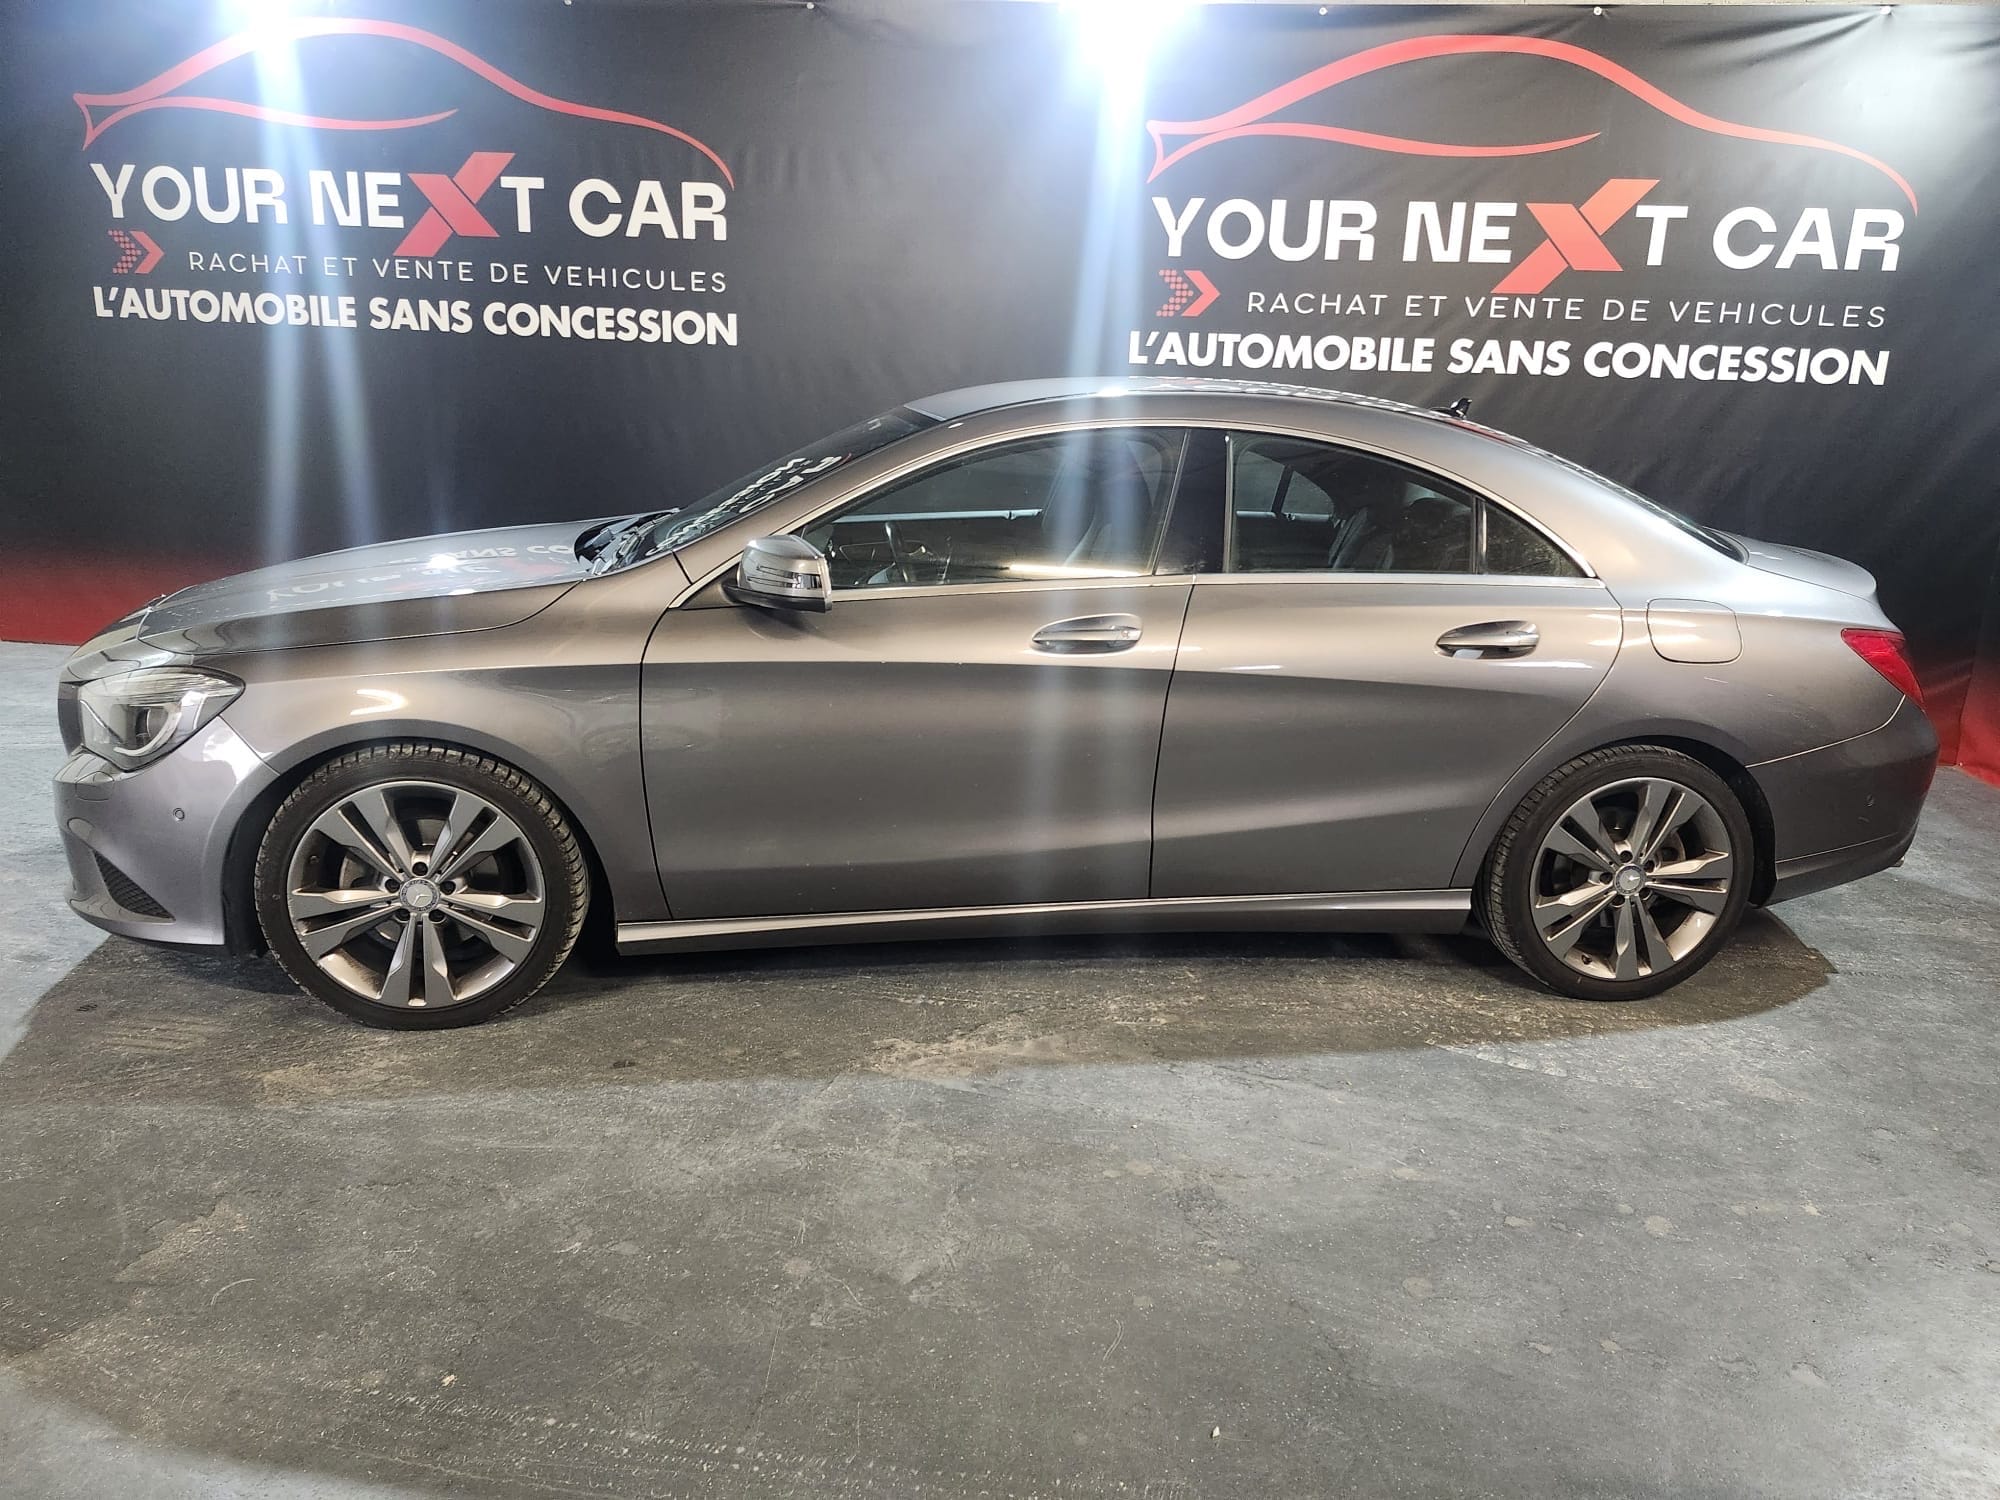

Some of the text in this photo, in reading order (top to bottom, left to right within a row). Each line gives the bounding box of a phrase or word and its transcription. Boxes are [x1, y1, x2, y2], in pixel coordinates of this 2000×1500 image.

[90, 151, 728, 258] YOUR NEXT CAR
[1151, 178, 1905, 294] YOUR NEXT CAR
[188, 251, 727, 293] RACHAT ET VENTE DE VEHICULES
[93, 286, 739, 346] L'AUTOMOBILE SANS CONCESSION
[1247, 291, 1886, 328] RACHAT ET VENTE DE VEHICULES
[1128, 330, 1890, 386] L'AUTOMOBILE SANS CONCESSION
